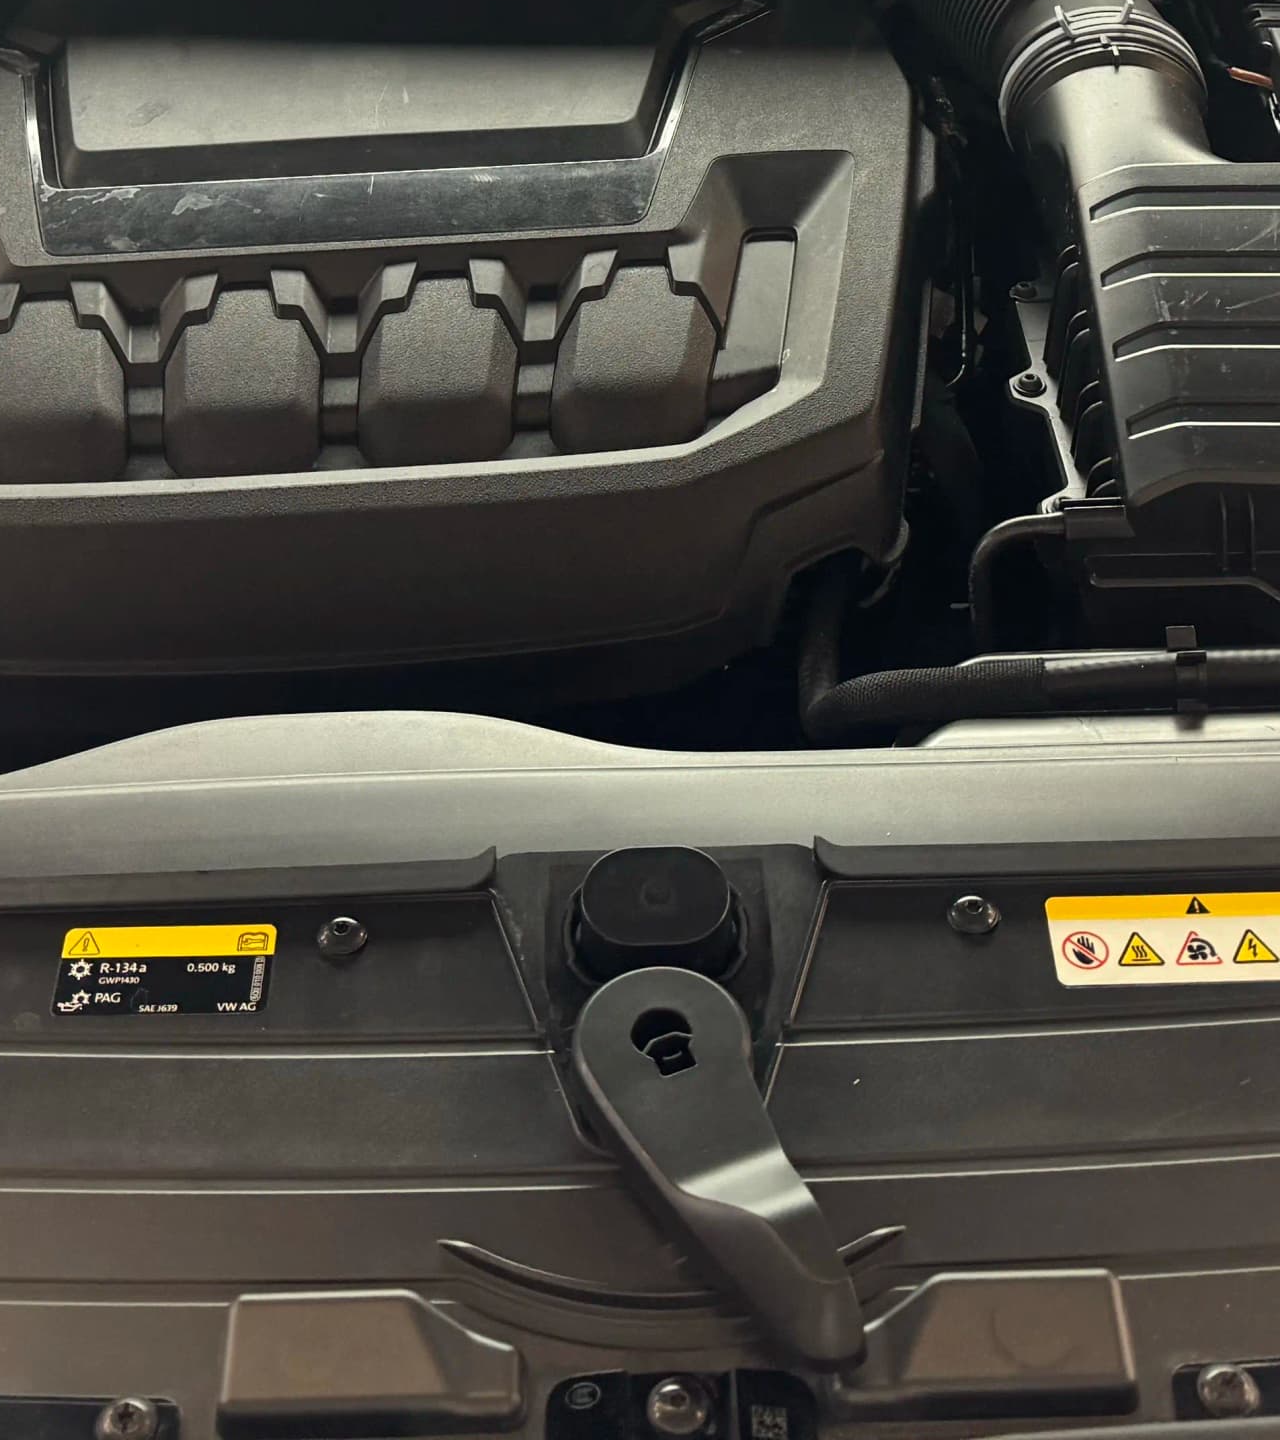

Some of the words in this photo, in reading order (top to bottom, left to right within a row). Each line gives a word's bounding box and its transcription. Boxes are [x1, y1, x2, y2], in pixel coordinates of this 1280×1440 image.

[186, 962, 219, 973] 0.500
[222, 962, 236, 975] kg
[94, 992, 122, 1004] PAG
[138, 1004, 155, 1013] SAE
[216, 1002, 237, 1012] VW
[239, 1002, 257, 1012] AG
